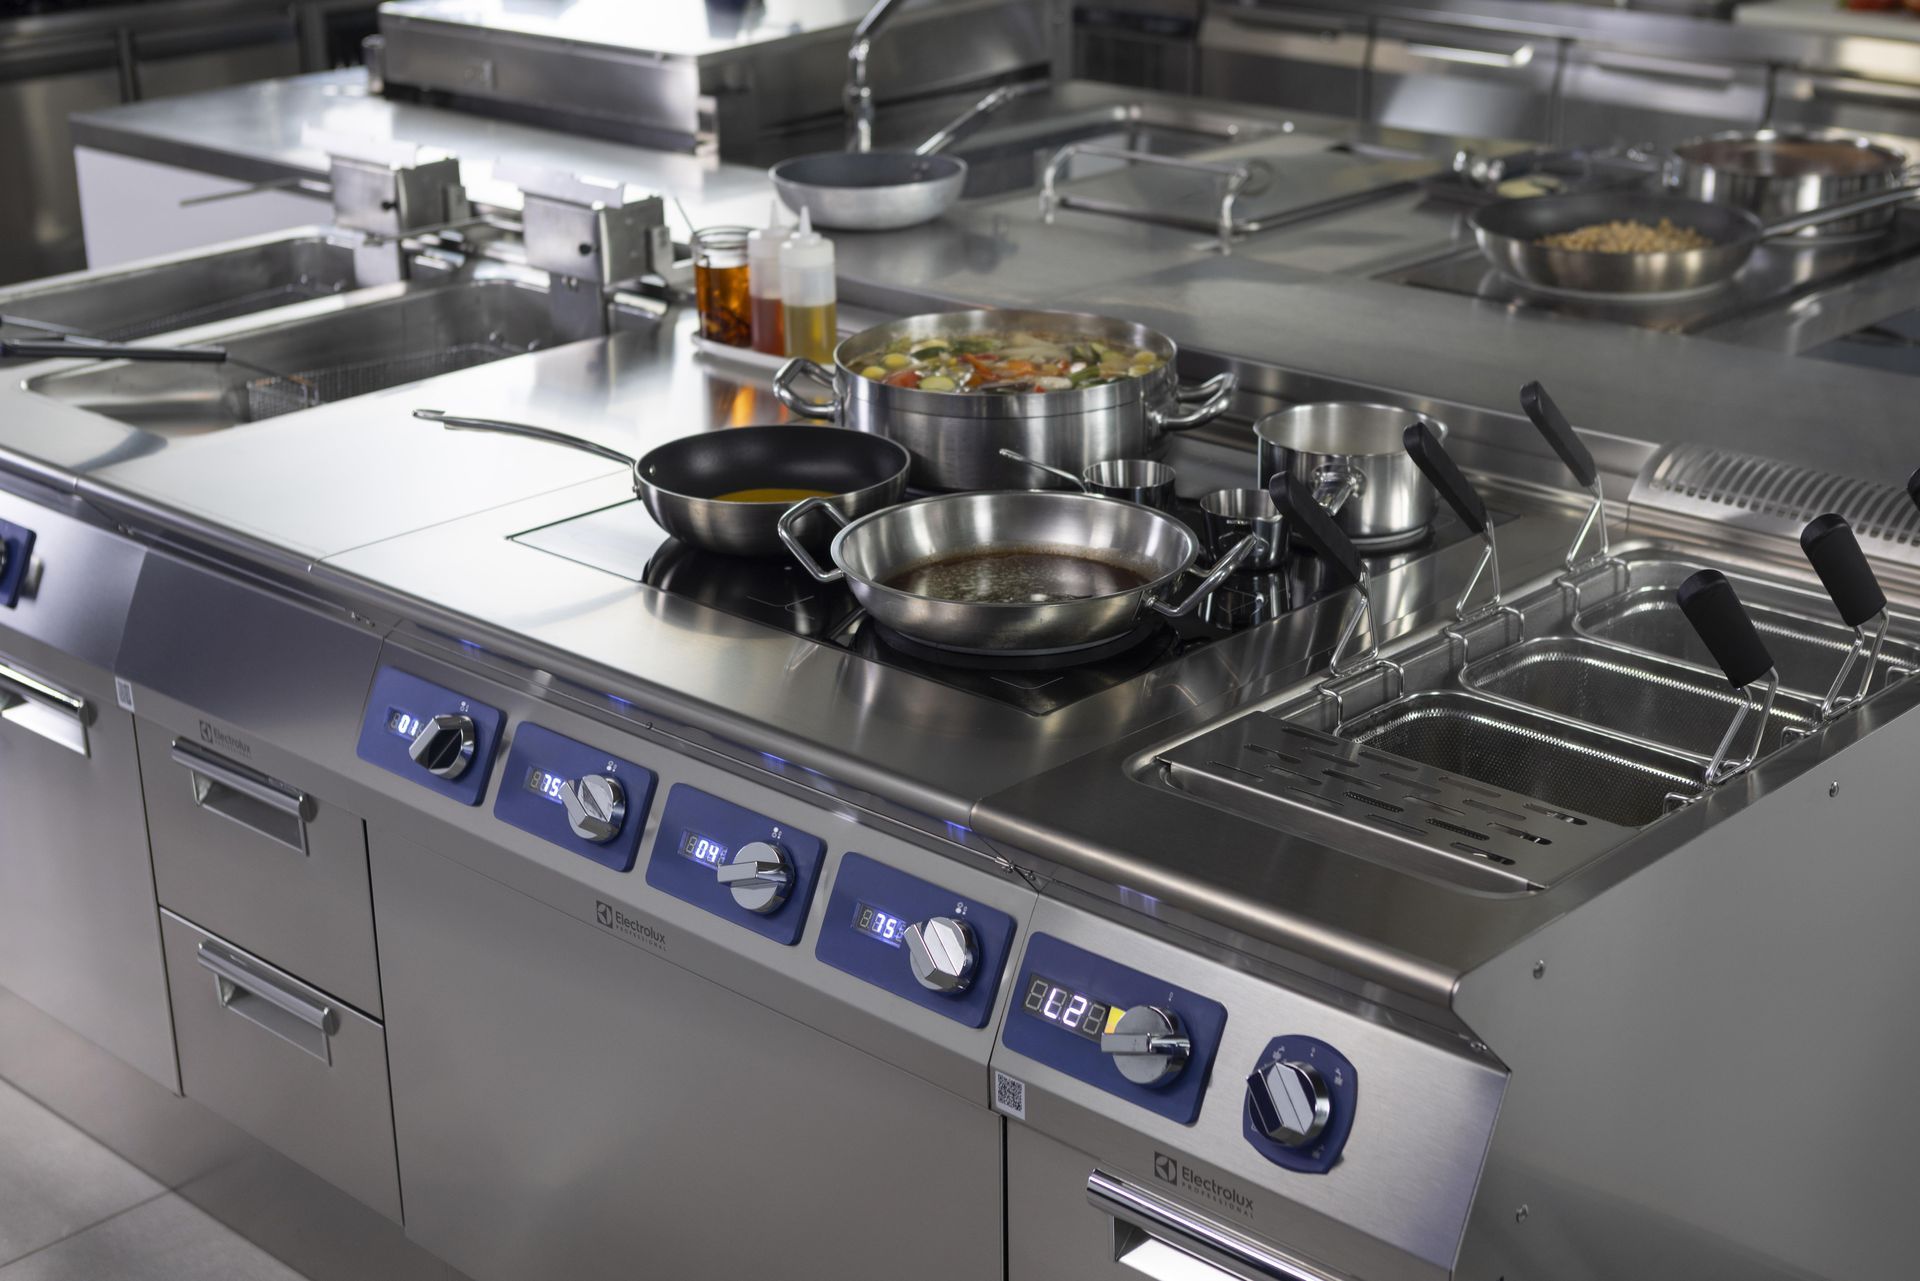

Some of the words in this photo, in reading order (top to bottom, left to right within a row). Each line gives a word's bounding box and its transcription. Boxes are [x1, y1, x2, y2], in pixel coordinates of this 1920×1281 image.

[398, 714, 419, 736] 01
[543, 773, 562, 799] 75
[695, 839, 720, 863] 04
[615, 910, 666, 945] Electrolux
[877, 912, 898, 939] 75
[1044, 987, 1088, 1028] L2
[1181, 1165, 1254, 1211] Electrolux
